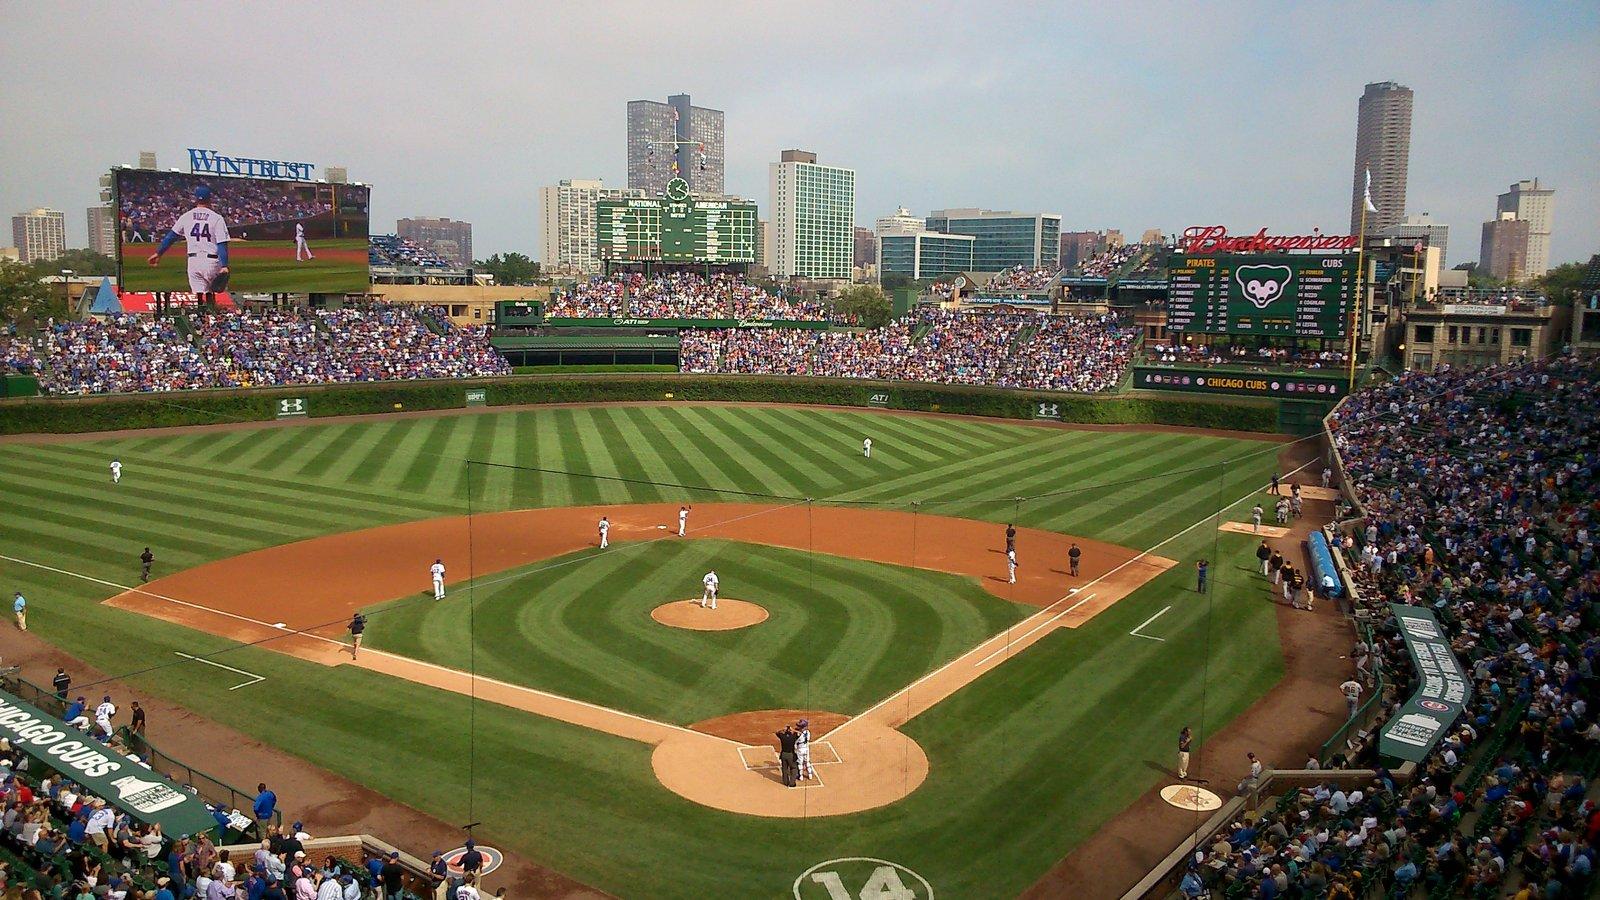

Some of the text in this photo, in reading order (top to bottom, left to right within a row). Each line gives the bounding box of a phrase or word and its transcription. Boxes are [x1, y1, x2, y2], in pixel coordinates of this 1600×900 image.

[188, 148, 315, 180] WINTRUST
[192, 212, 209, 221] RIZZO
[190, 223, 211, 242] 44
[1184, 226, 1360, 254] Budweiser
[1186, 259, 1215, 267] PIRATES
[1322, 259, 1343, 267] CUBS
[737, 319, 773, 327] Budweiser
[1207, 378, 1267, 390] CHICAGO CUBS
[870, 394, 889, 402] ATI
[1392, 725, 1433, 738] CHICAGO
[47, 741, 121, 777] CUBS
[810, 865, 919, 900] 14
